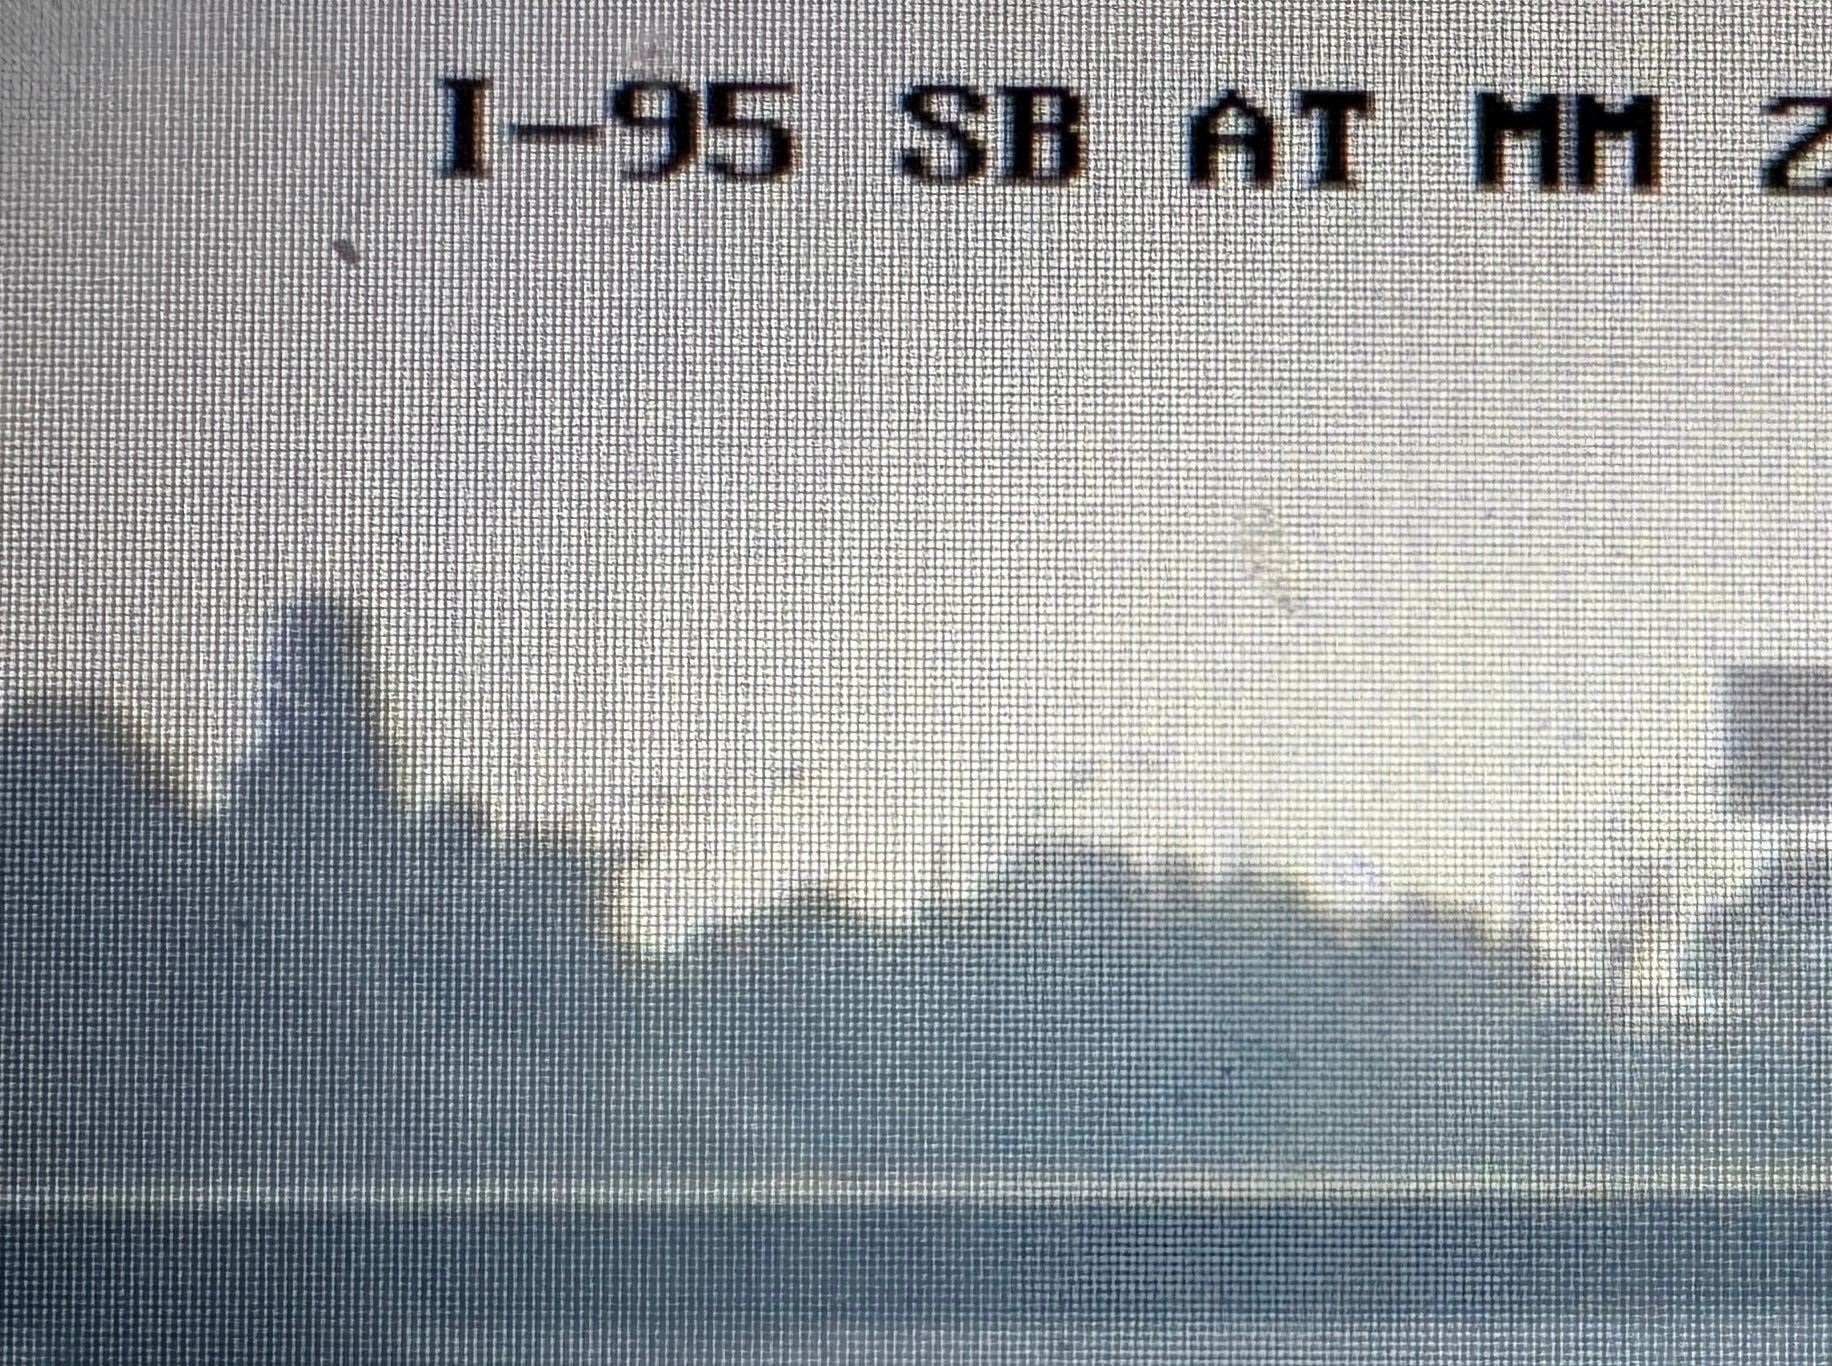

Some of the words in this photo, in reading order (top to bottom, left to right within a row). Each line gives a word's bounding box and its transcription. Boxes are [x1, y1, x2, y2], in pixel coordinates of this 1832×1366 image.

[436, 76, 796, 182] I-95
[899, 83, 1088, 187] SB
[1188, 88, 1376, 189] AT
[1474, 90, 1663, 190] MM
